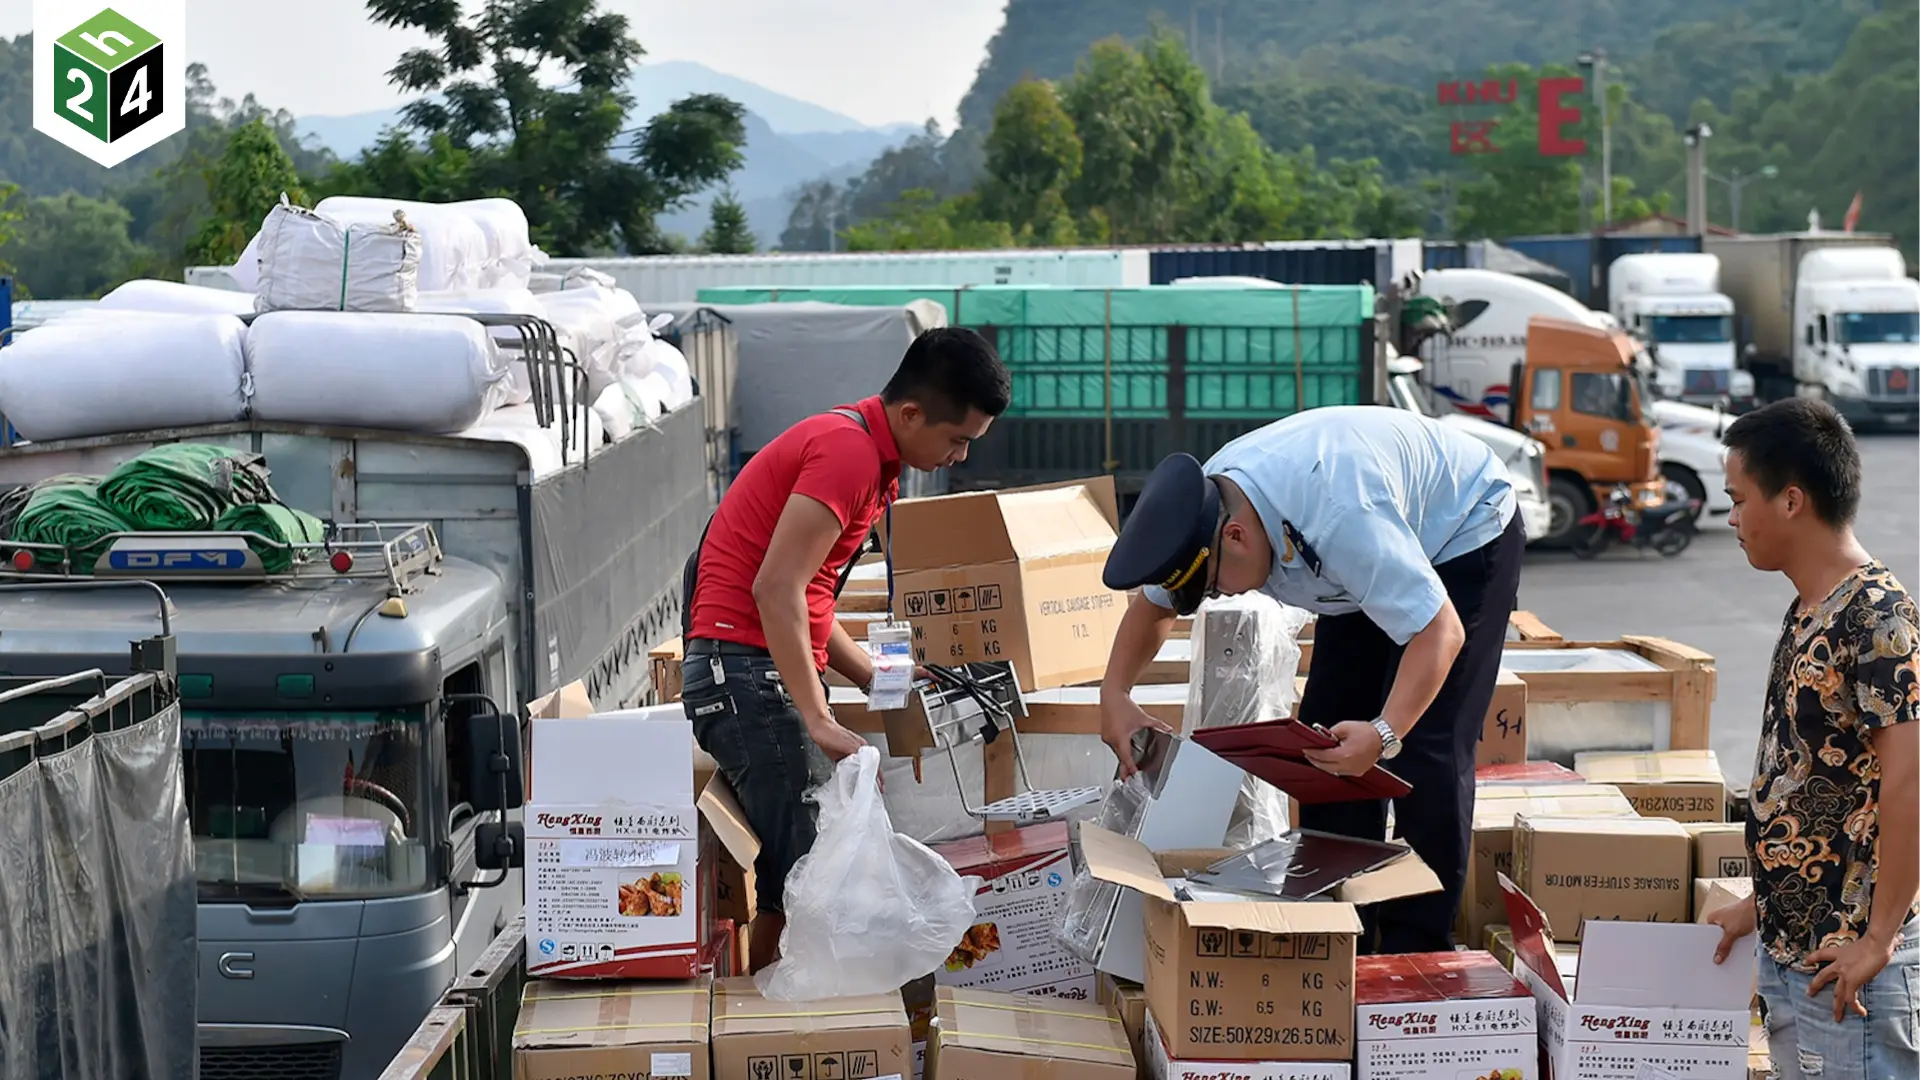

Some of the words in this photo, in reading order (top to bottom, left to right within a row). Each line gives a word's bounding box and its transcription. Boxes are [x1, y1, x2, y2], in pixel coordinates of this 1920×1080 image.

[1438, 79, 1518, 105] KHU
[1538, 77, 1588, 156] E
[126, 552, 228, 567] DFM
[1039, 600, 1066, 616] VERTICAL
[1066, 596, 1091, 612] SAUSAGE
[1091, 593, 1114, 610] STUFFER
[952, 624, 959, 636] 6
[981, 618, 997, 634] KG
[983, 640, 1001, 656] KG
[537, 813, 602, 828] HengXing
[1545, 874, 1583, 888] MOTOR
[1585, 876, 1631, 889] STUFFER
[1633, 877, 1680, 890] SAUSAGE
[1189, 970, 1224, 988] N.W:
[1262, 974, 1270, 987] 6
[1302, 973, 1324, 989] KG
[1190, 999, 1223, 1016] G.W:
[1256, 1001, 1274, 1015] 6.5
[1302, 1001, 1322, 1017] KG
[1369, 1012, 1438, 1030] HengXing
[1580, 1015, 1651, 1032] HengXing
